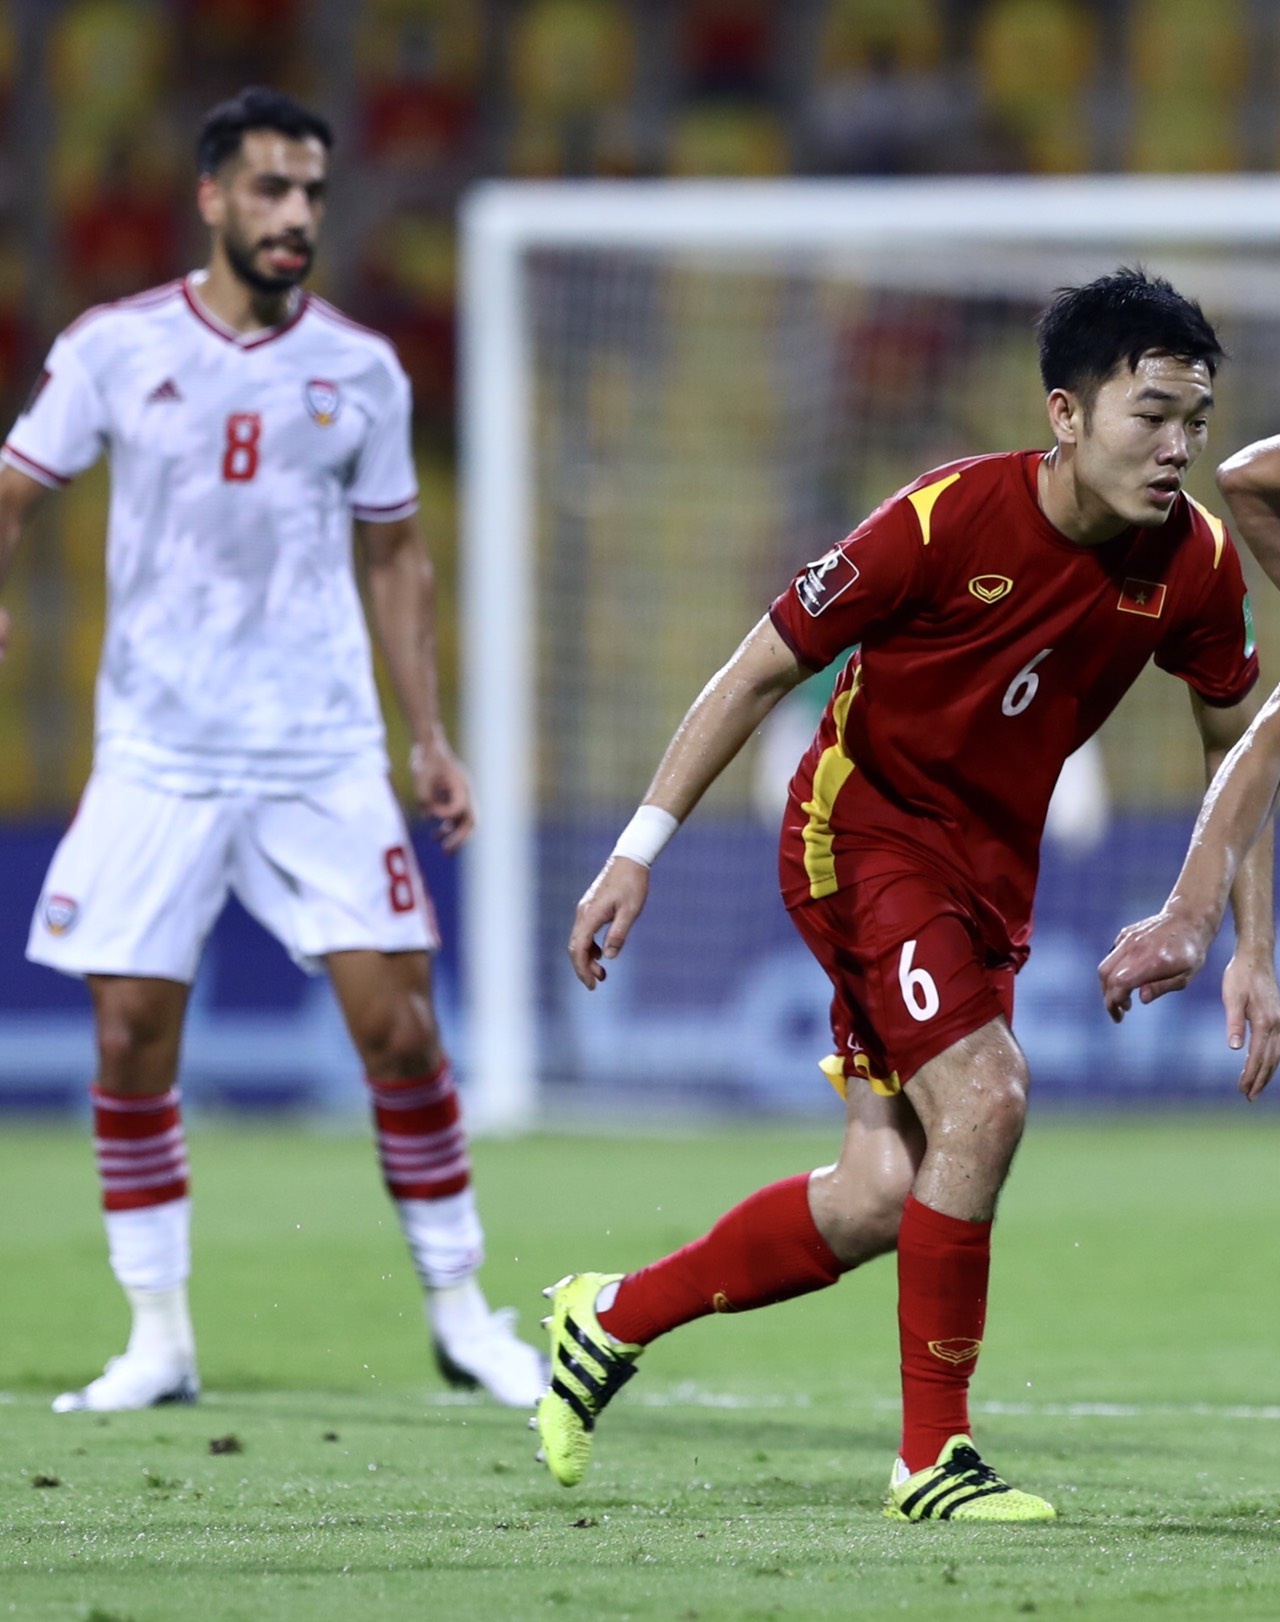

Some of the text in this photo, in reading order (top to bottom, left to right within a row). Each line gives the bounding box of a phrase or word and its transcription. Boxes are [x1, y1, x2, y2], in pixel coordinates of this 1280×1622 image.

[222, 412, 262, 482] 8
[1002, 648, 1053, 717] 6
[384, 845, 416, 914] 8
[899, 939, 940, 1021] 6
